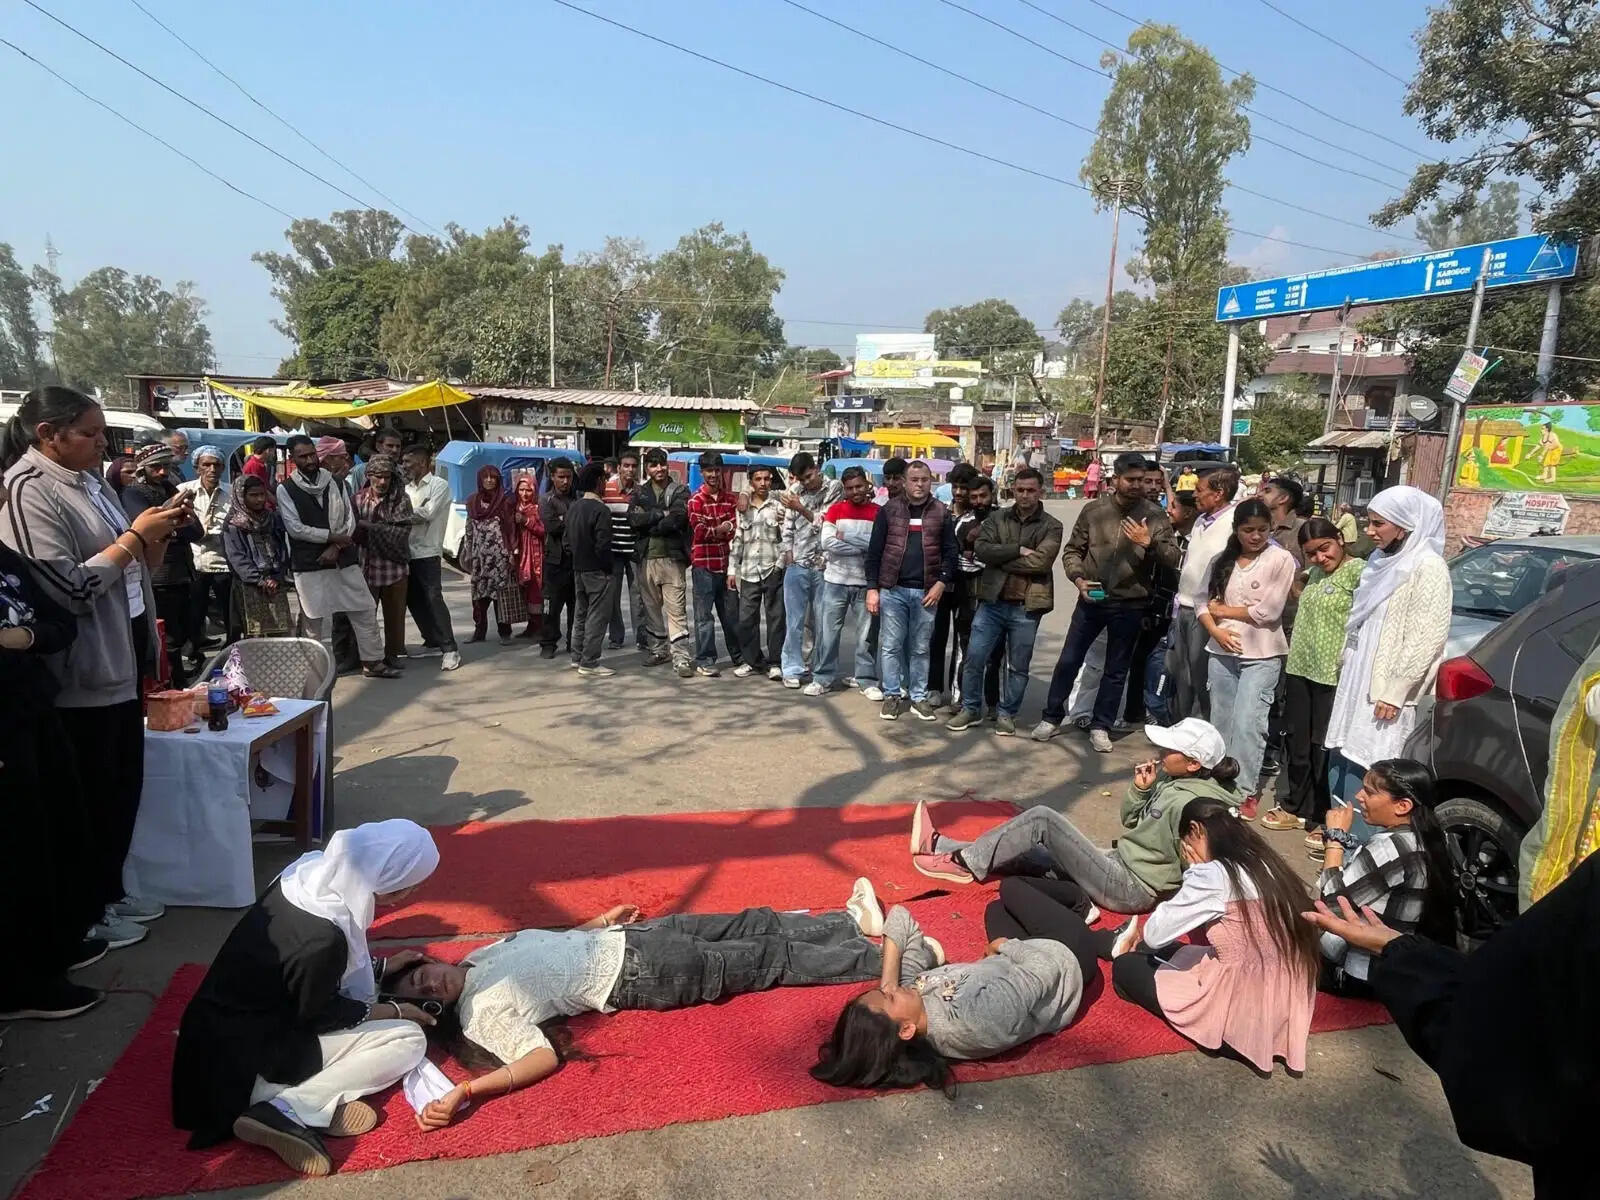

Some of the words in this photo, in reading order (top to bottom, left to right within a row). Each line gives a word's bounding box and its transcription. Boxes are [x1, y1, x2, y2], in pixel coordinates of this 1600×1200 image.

[1401, 256, 1422, 265] HAPPY
[1423, 252, 1454, 261] JOURNEY
[659, 423, 684, 435] Kulfi
